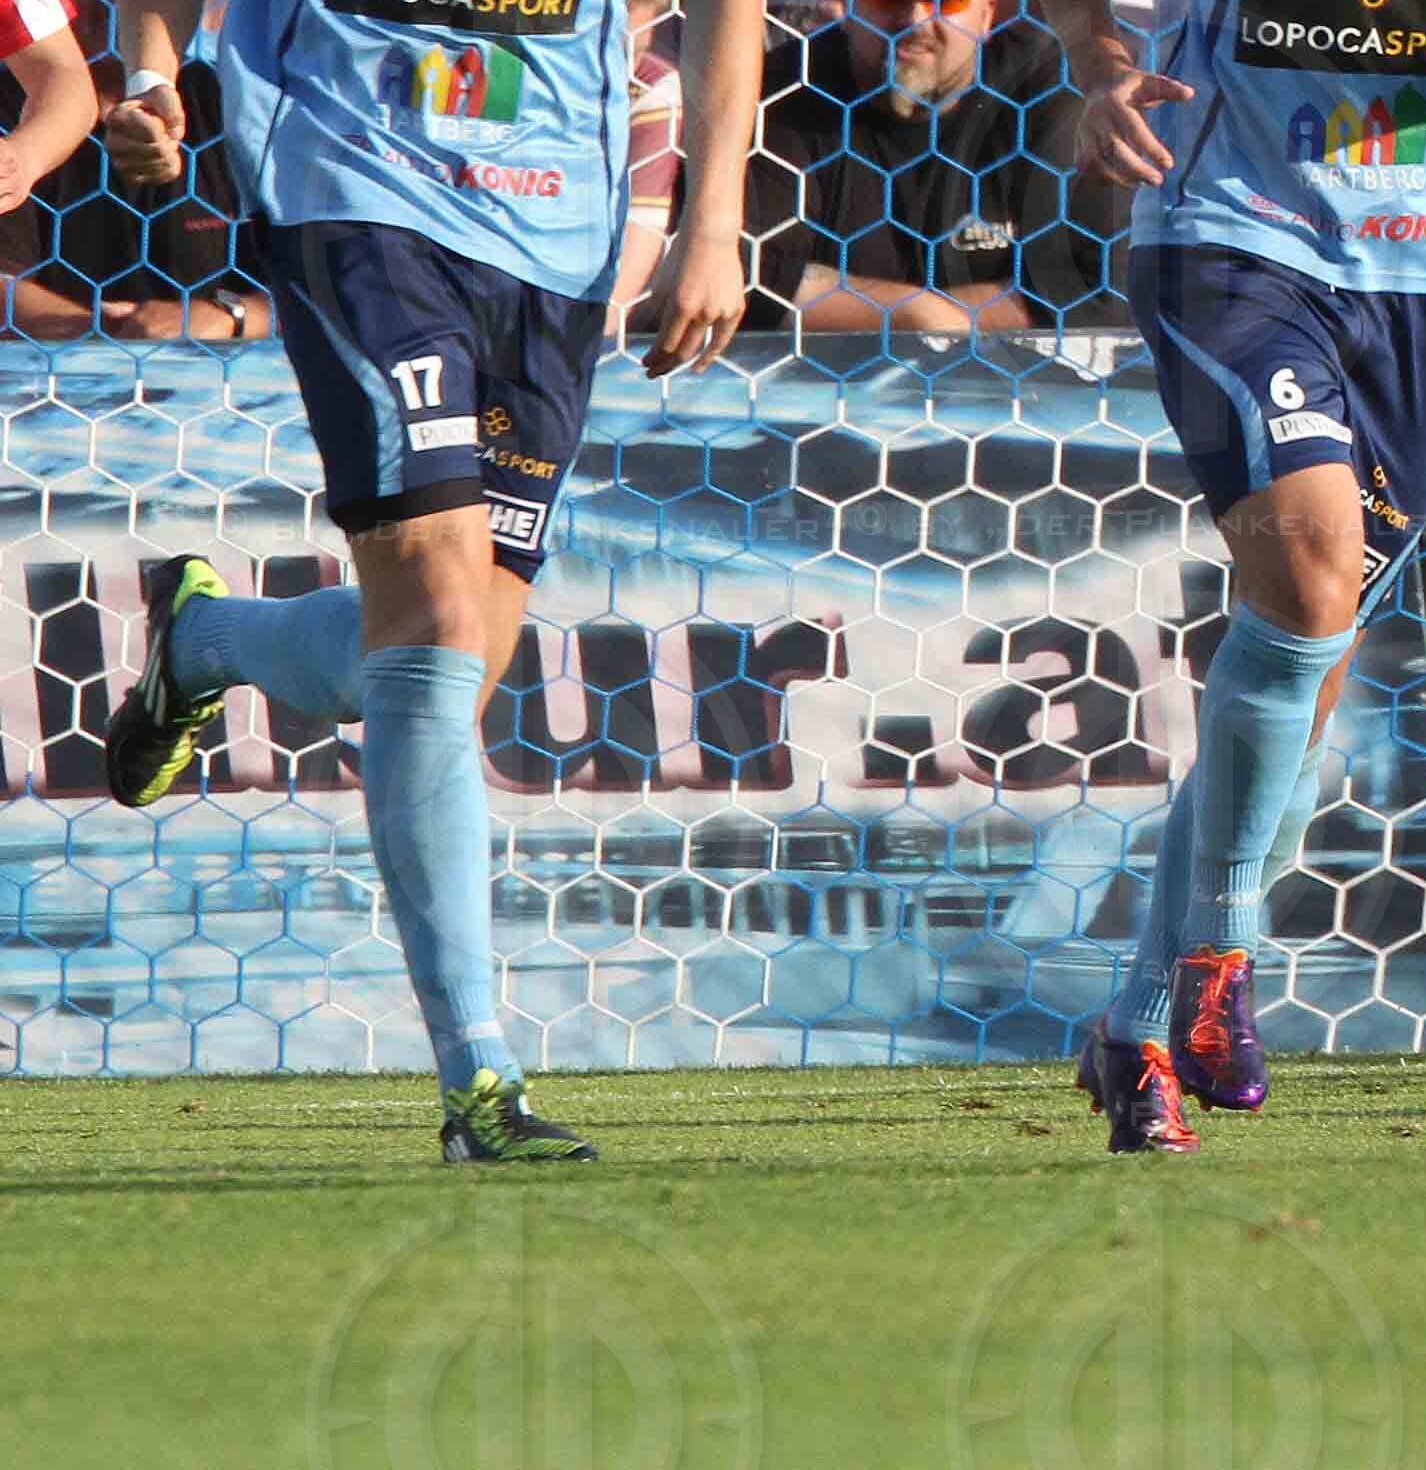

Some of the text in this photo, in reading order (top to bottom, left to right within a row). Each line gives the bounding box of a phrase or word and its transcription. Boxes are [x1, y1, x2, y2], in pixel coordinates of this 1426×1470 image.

[1300, 162, 1426, 192] ARTBERG
[390, 354, 443, 411] 17
[1269, 367, 1306, 411] 6
